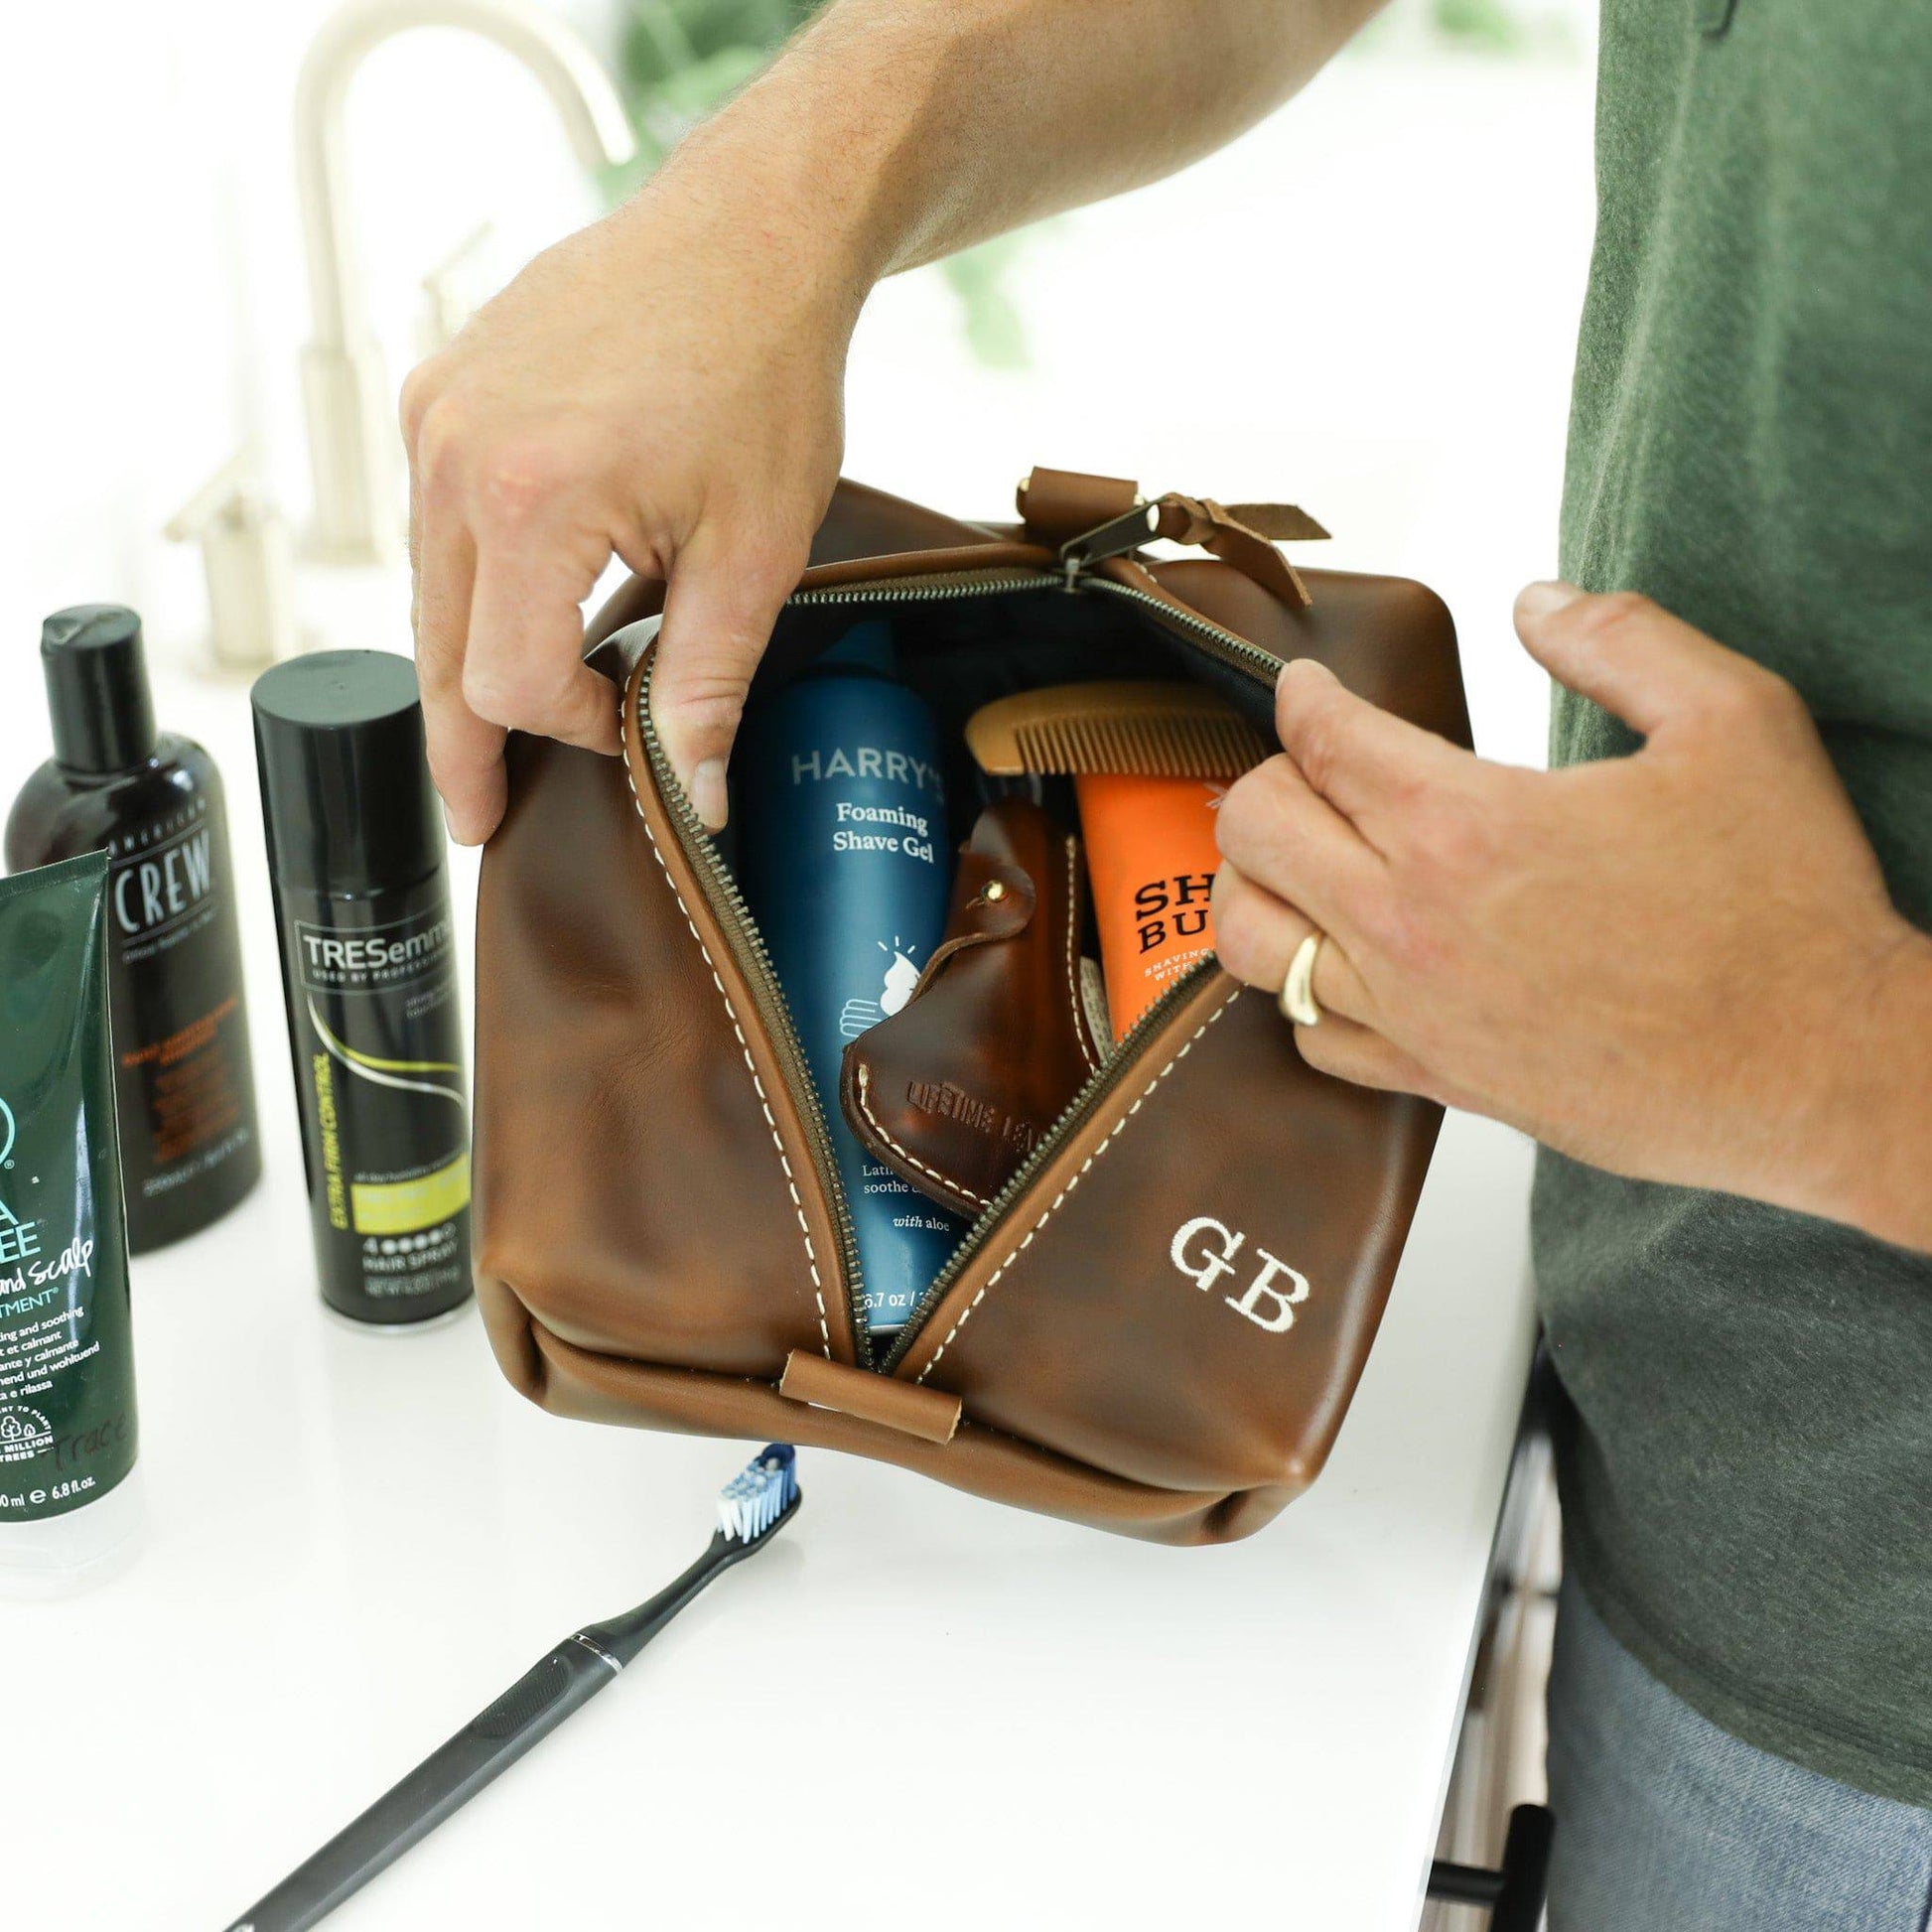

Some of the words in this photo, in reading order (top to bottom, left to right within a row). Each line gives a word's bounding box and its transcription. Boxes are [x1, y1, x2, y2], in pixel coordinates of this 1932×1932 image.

[836, 802, 928, 837] Foaming
[833, 830, 899, 852] Shave
[902, 837, 934, 864] Gel
[114, 829, 210, 933] CREW
[864, 1180, 908, 1194] soothe
[894, 1214, 923, 1228] with
[925, 1217, 950, 1231] aloe
[1171, 1217, 1311, 1333] GB
[889, 1294, 906, 1307] oz
[19, 1321, 40, 1337] and
[41, 1306, 84, 1330] soothing
[7, 1344, 20, 1355] et
[21, 1331, 63, 1351] calmant
[25, 1356, 32, 1367] y
[34, 1339, 79, 1362] calmante
[27, 1364, 48, 1379] und
[50, 1340, 100, 1372] wohltuend
[20, 1380, 54, 1396] rilassa
[31, 1409, 52, 1431] PLANT
[4, 1435, 54, 1452] MILLION
[11, 1493, 26, 1507] ml
[52, 1482, 70, 1499] 6.8
